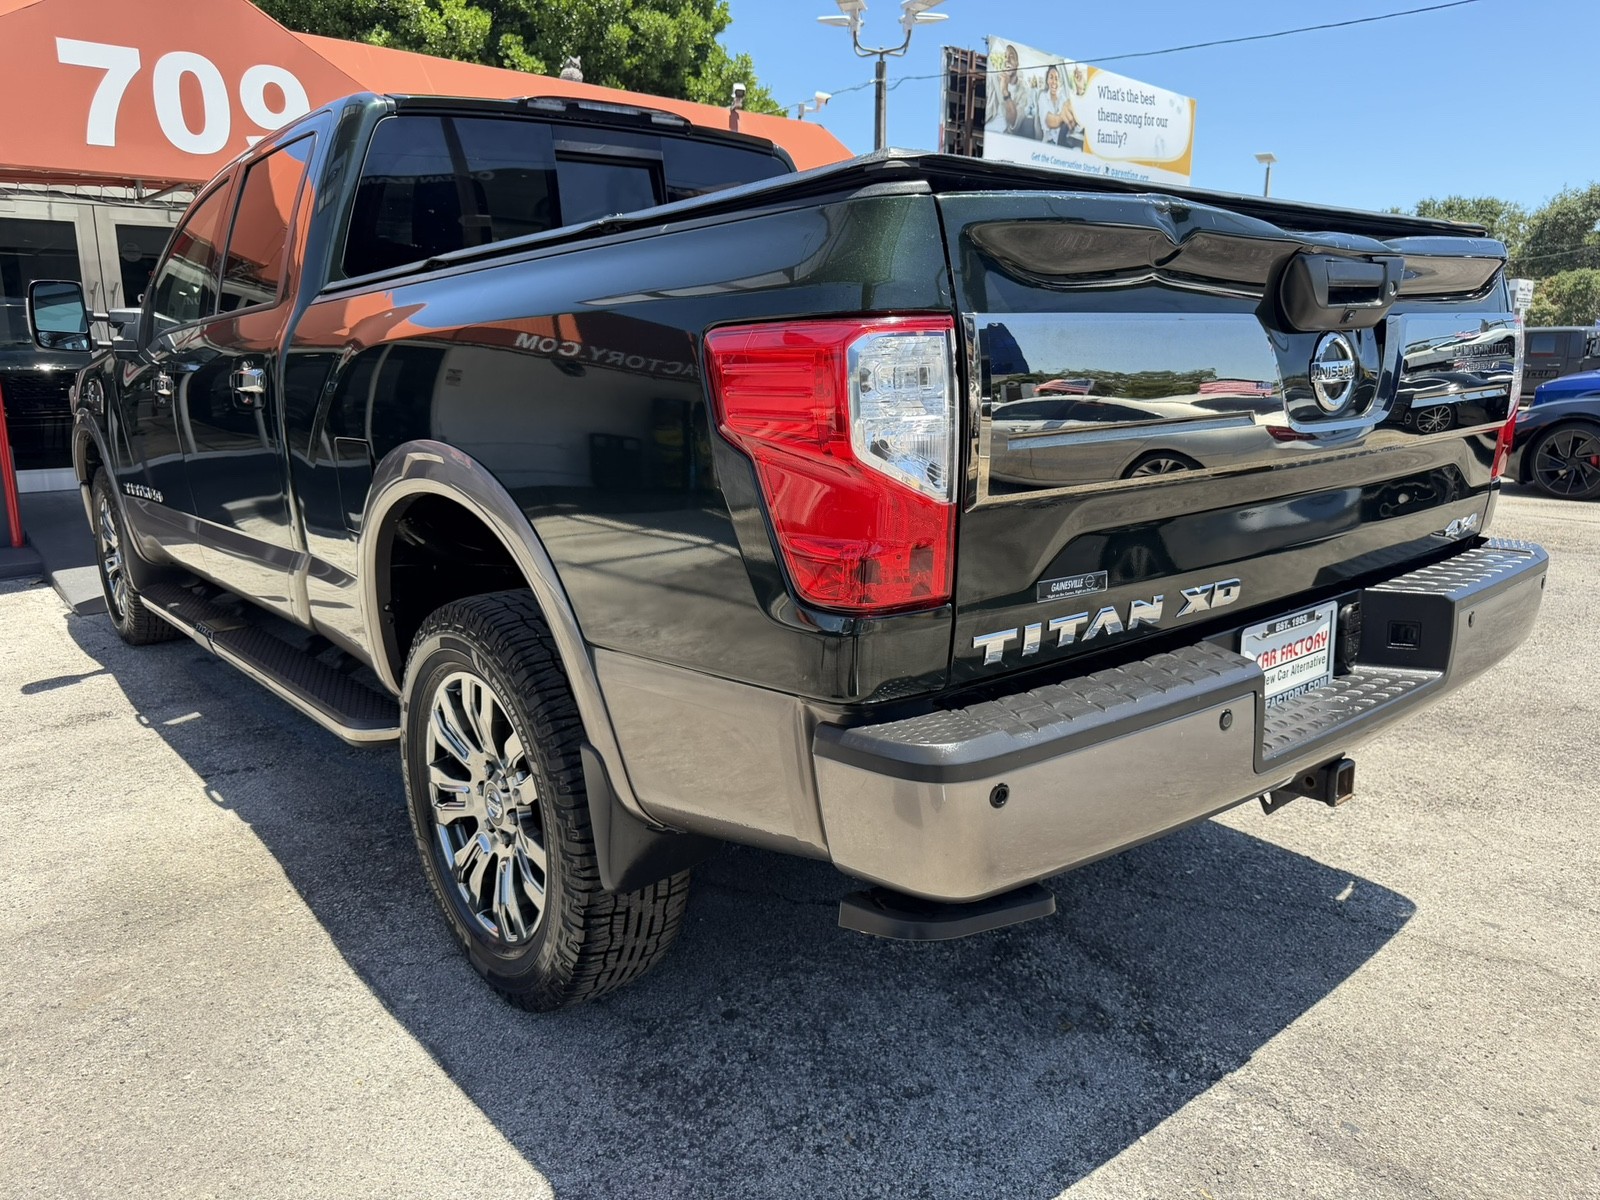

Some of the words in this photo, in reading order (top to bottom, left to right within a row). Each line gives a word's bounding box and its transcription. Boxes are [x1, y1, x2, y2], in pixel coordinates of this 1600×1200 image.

[55, 37, 311, 154] 709
[1097, 85, 1125, 102] What's
[1127, 89, 1139, 104] the
[1140, 91, 1156, 106] best
[1097, 107, 1122, 123] theme
[1124, 113, 1143, 129] song
[1144, 113, 1155, 127] for
[1156, 116, 1168, 128] our
[1097, 129, 1128, 149] family?
[1031, 152, 1040, 161] Get
[1040, 153, 1050, 163] the
[1051, 578, 1083, 592] GAINESVILLE
[972, 593, 1165, 666] TITAN
[1175, 577, 1241, 618] XD
[1275, 622, 1292, 632] EST.
[1281, 631, 1328, 661] FACTORY
[1265, 673, 1276, 686] ew
[1277, 668, 1290, 681] Car
[1290, 655, 1326, 677] Alternative
